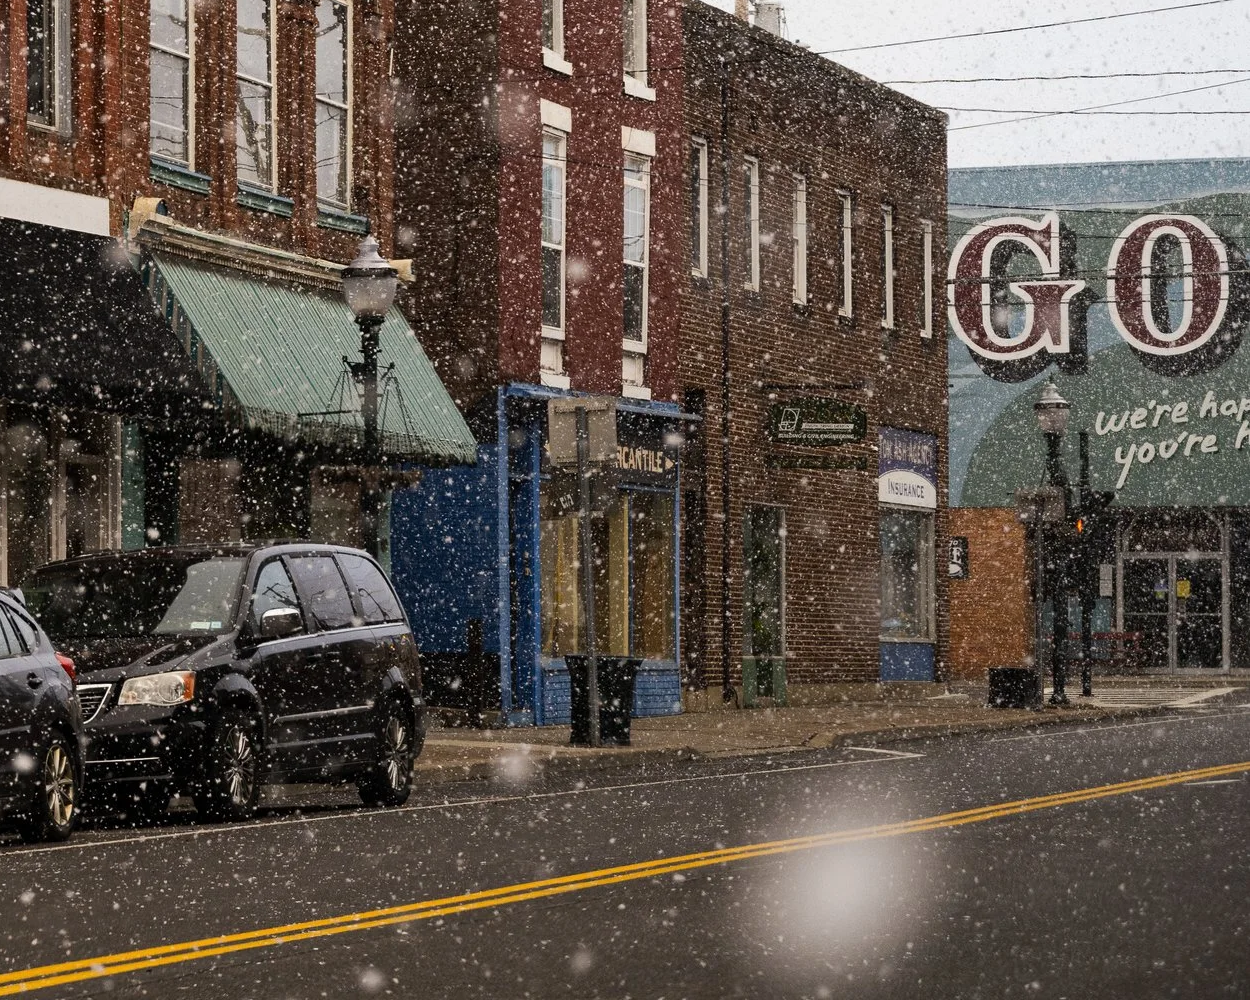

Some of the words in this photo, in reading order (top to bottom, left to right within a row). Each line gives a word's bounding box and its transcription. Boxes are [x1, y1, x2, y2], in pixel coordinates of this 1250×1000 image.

[1095, 400, 1189, 435] we're
[1114, 431, 1218, 489] you're
[888, 478, 925, 499] INSURANCE
